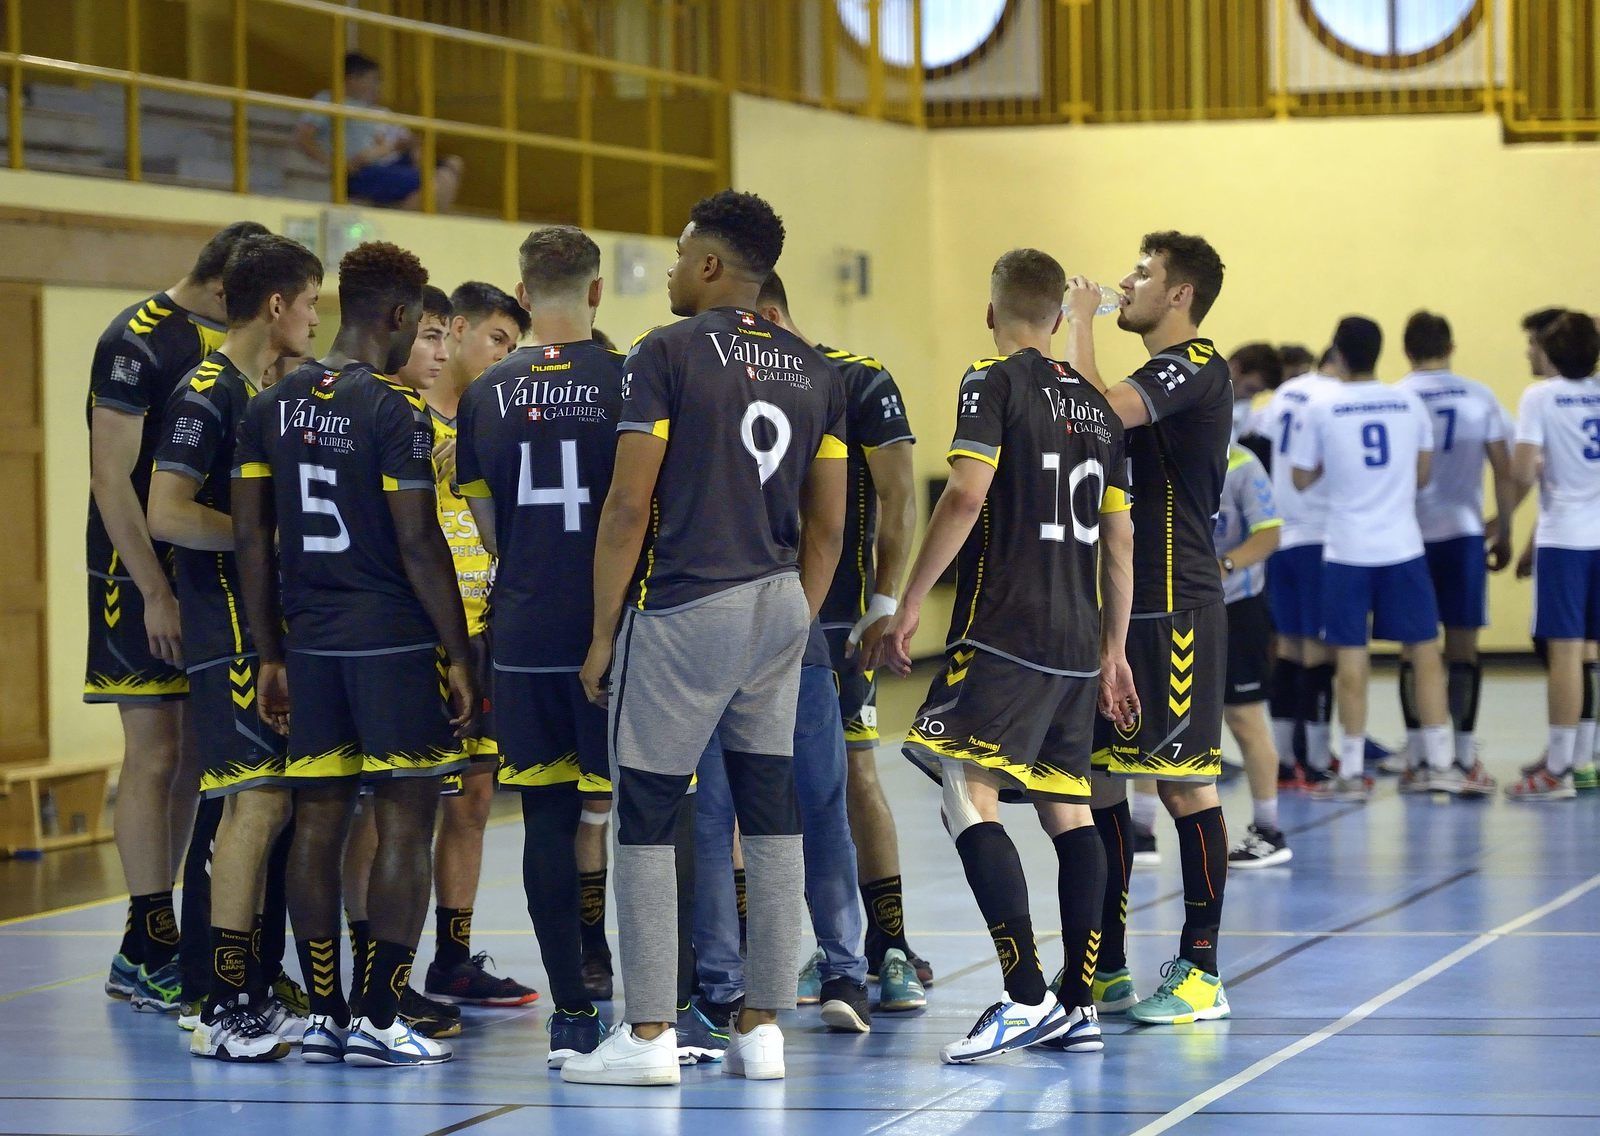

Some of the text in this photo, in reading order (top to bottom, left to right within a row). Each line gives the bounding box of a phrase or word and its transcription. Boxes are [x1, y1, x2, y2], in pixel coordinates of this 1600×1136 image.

[737, 327, 772, 339] hummel
[532, 361, 571, 373] hummel
[705, 332, 804, 372] Valloire
[492, 376, 600, 419] Valloire
[543, 406, 608, 421] GALIBIER
[317, 436, 356, 451] ALIBIER
[741, 399, 792, 490] 9
[1361, 421, 1390, 467] 9
[1436, 408, 1457, 451] 7
[1583, 418, 1600, 460] 3
[517, 439, 591, 532] 4
[1040, 452, 1104, 546] 10
[298, 463, 350, 553] 5
[918, 716, 945, 736] 10
[968, 735, 1001, 753] hummel
[1112, 743, 1140, 755] hummel
[1172, 743, 1183, 759] 7
[1004, 1019, 1026, 1027] Kempa
